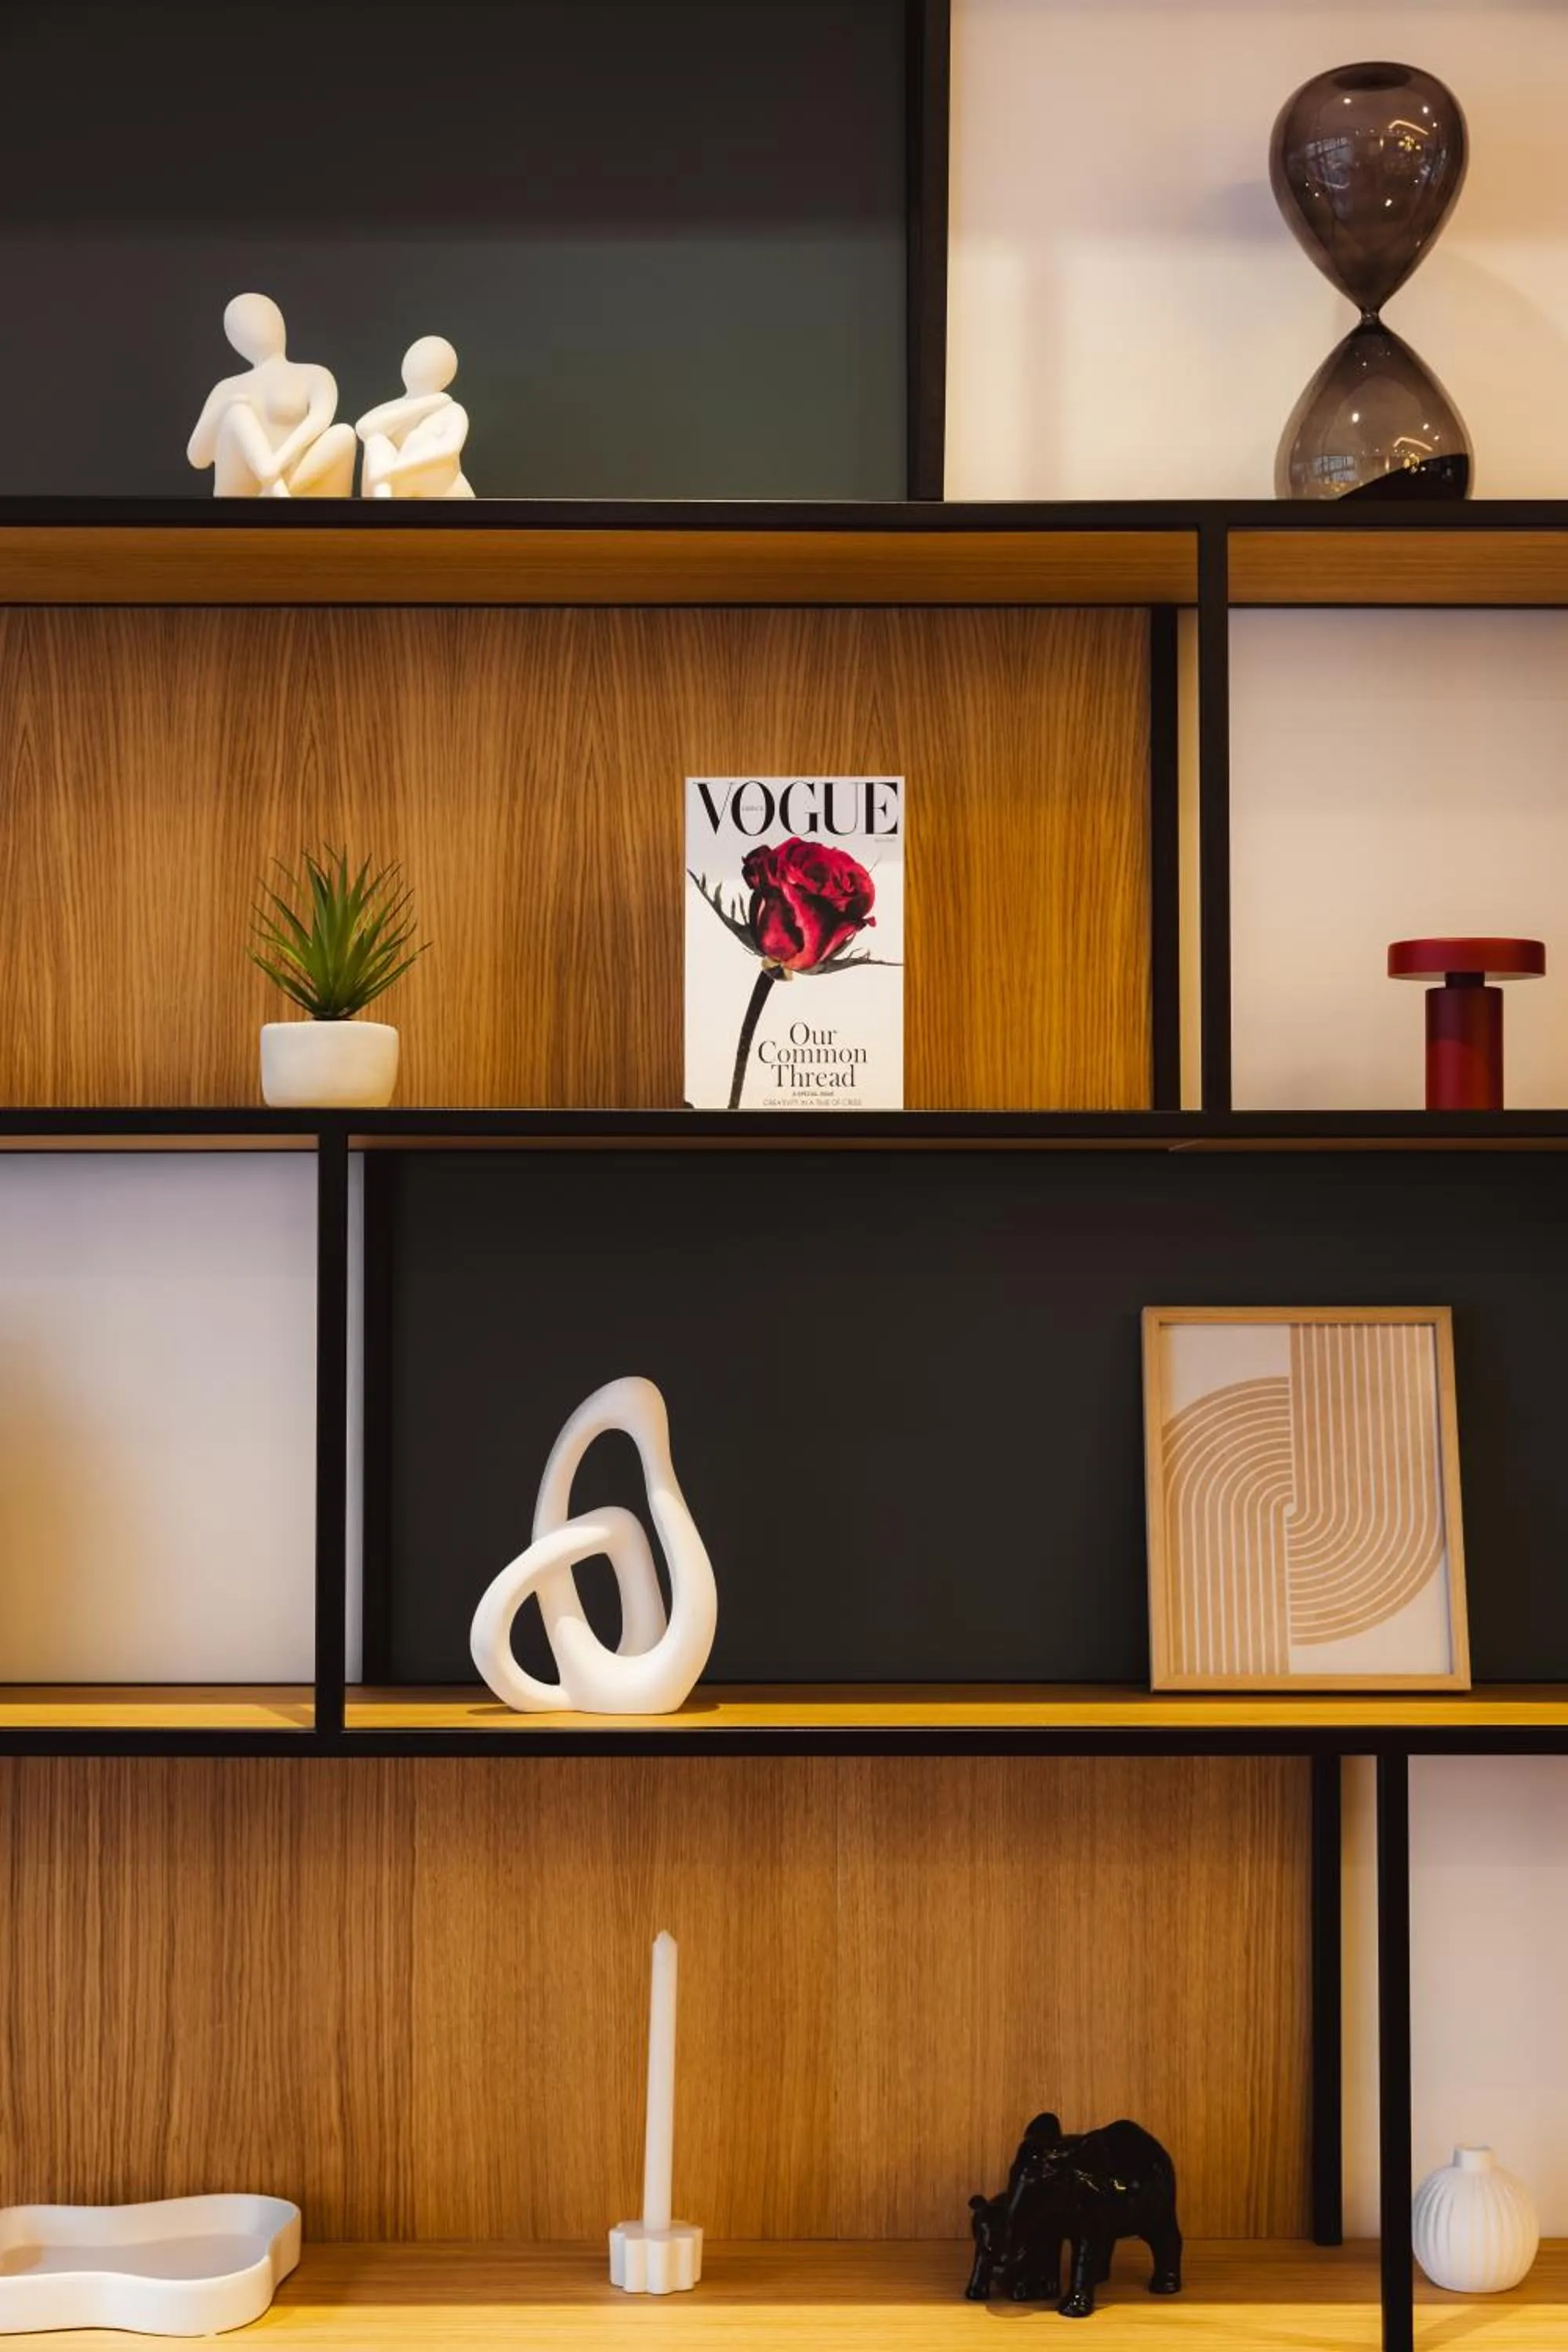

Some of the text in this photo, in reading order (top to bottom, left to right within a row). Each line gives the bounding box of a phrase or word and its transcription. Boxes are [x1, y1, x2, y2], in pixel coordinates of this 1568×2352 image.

[693, 781, 898, 836] VOGUE
[789, 1022, 837, 1045] Our
[758, 1040, 867, 1064] Common
[771, 1064, 856, 1087] Thread
